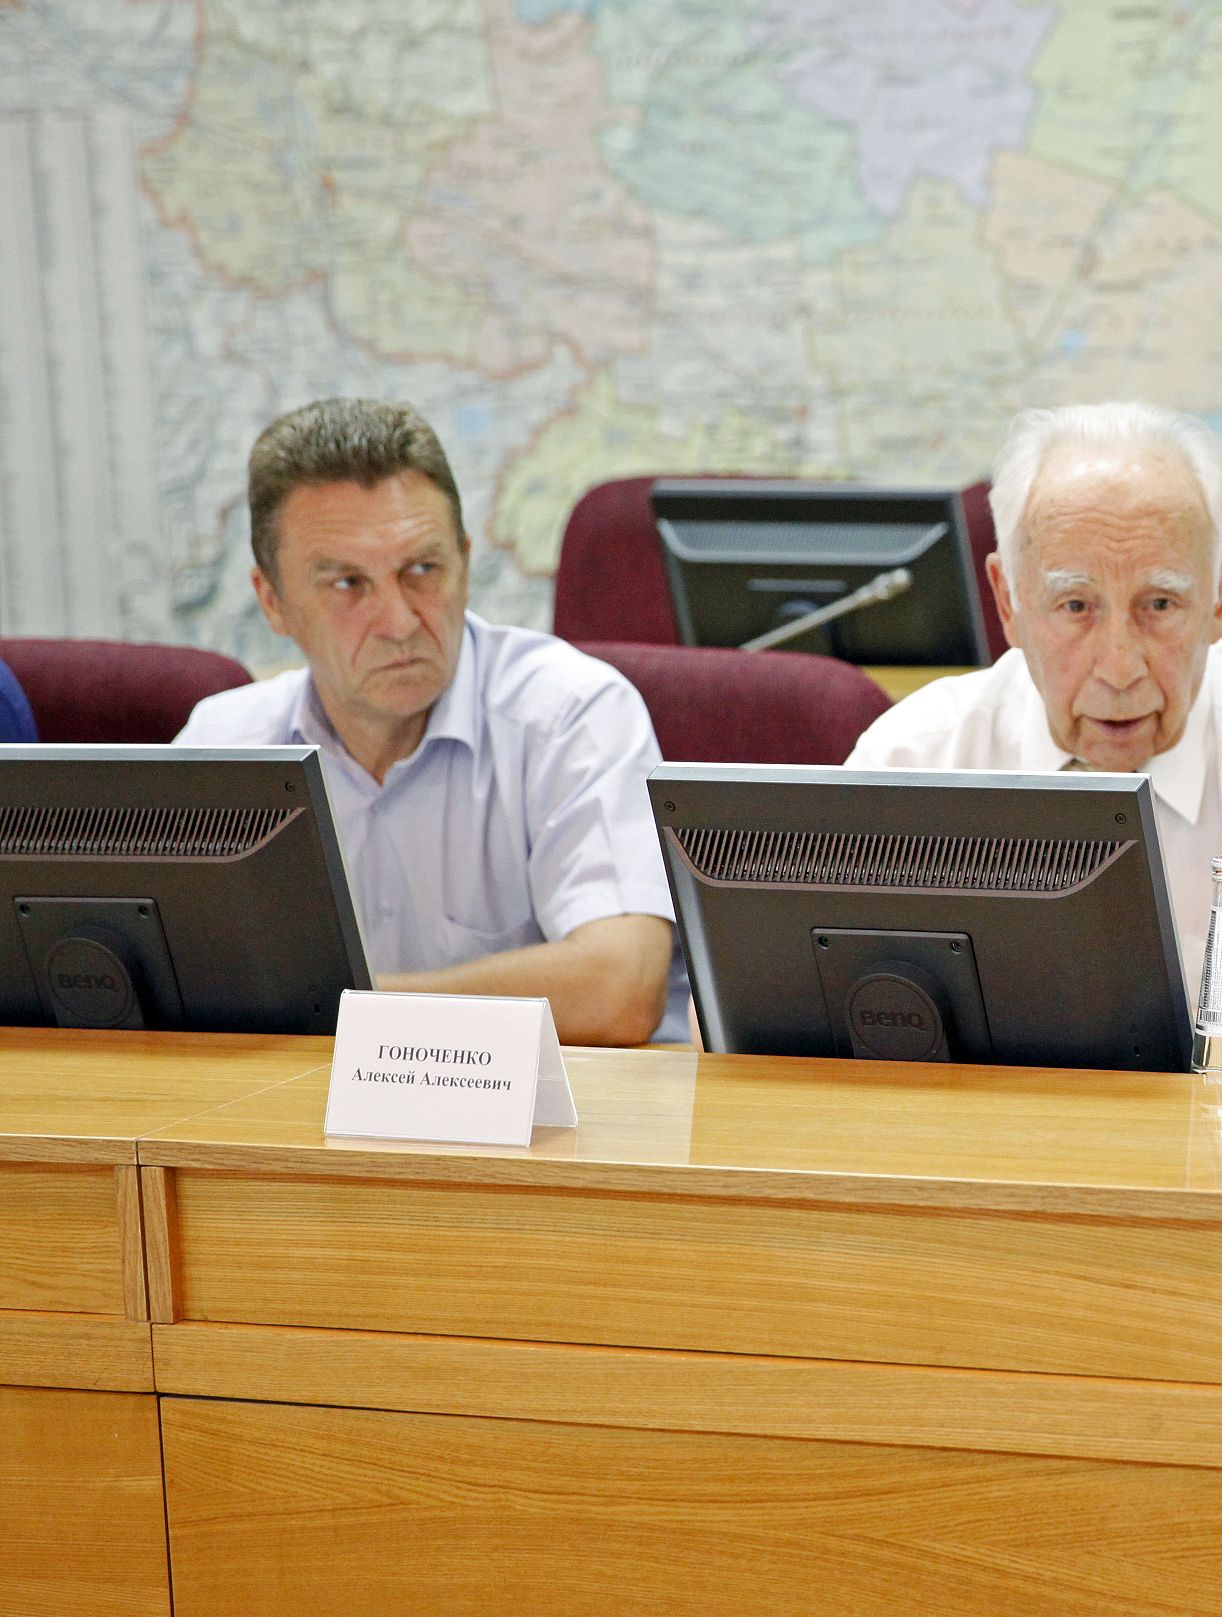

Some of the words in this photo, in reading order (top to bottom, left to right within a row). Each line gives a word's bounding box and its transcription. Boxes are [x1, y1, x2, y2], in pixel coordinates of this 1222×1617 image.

[57, 972, 120, 993] BenQ
[859, 1010, 928, 1031] BenQ
[378, 1045, 492, 1066] ГОНОЧЕНКО
[351, 1067, 416, 1085] Алексей
[419, 1072, 512, 1091] Алексеевич
